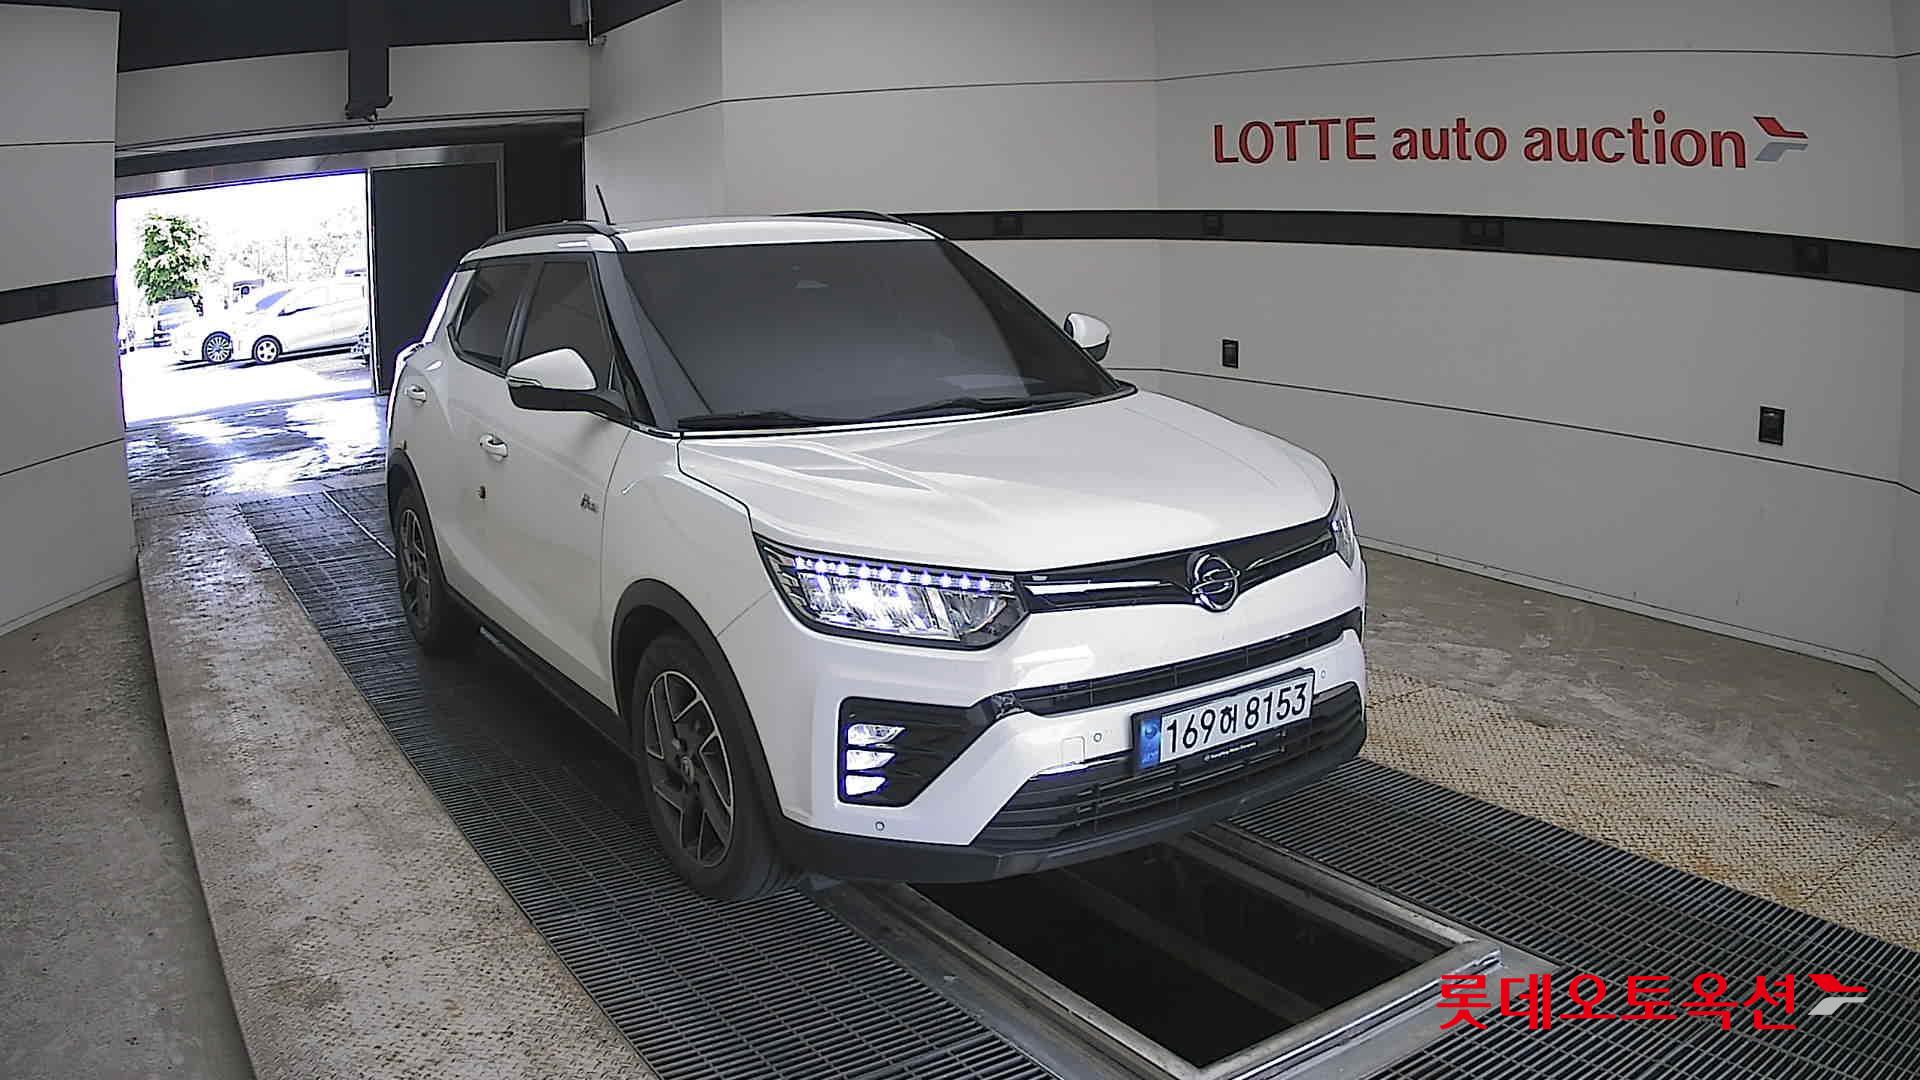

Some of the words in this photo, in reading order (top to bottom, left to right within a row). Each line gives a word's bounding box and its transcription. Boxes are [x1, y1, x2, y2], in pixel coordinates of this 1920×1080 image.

[1213, 116, 1377, 164] LOTTE
[1391, 117, 1508, 161] auto
[1523, 109, 1747, 169] auction
[1166, 704, 1238, 753] 169허
[1244, 682, 1307, 730] 8153
